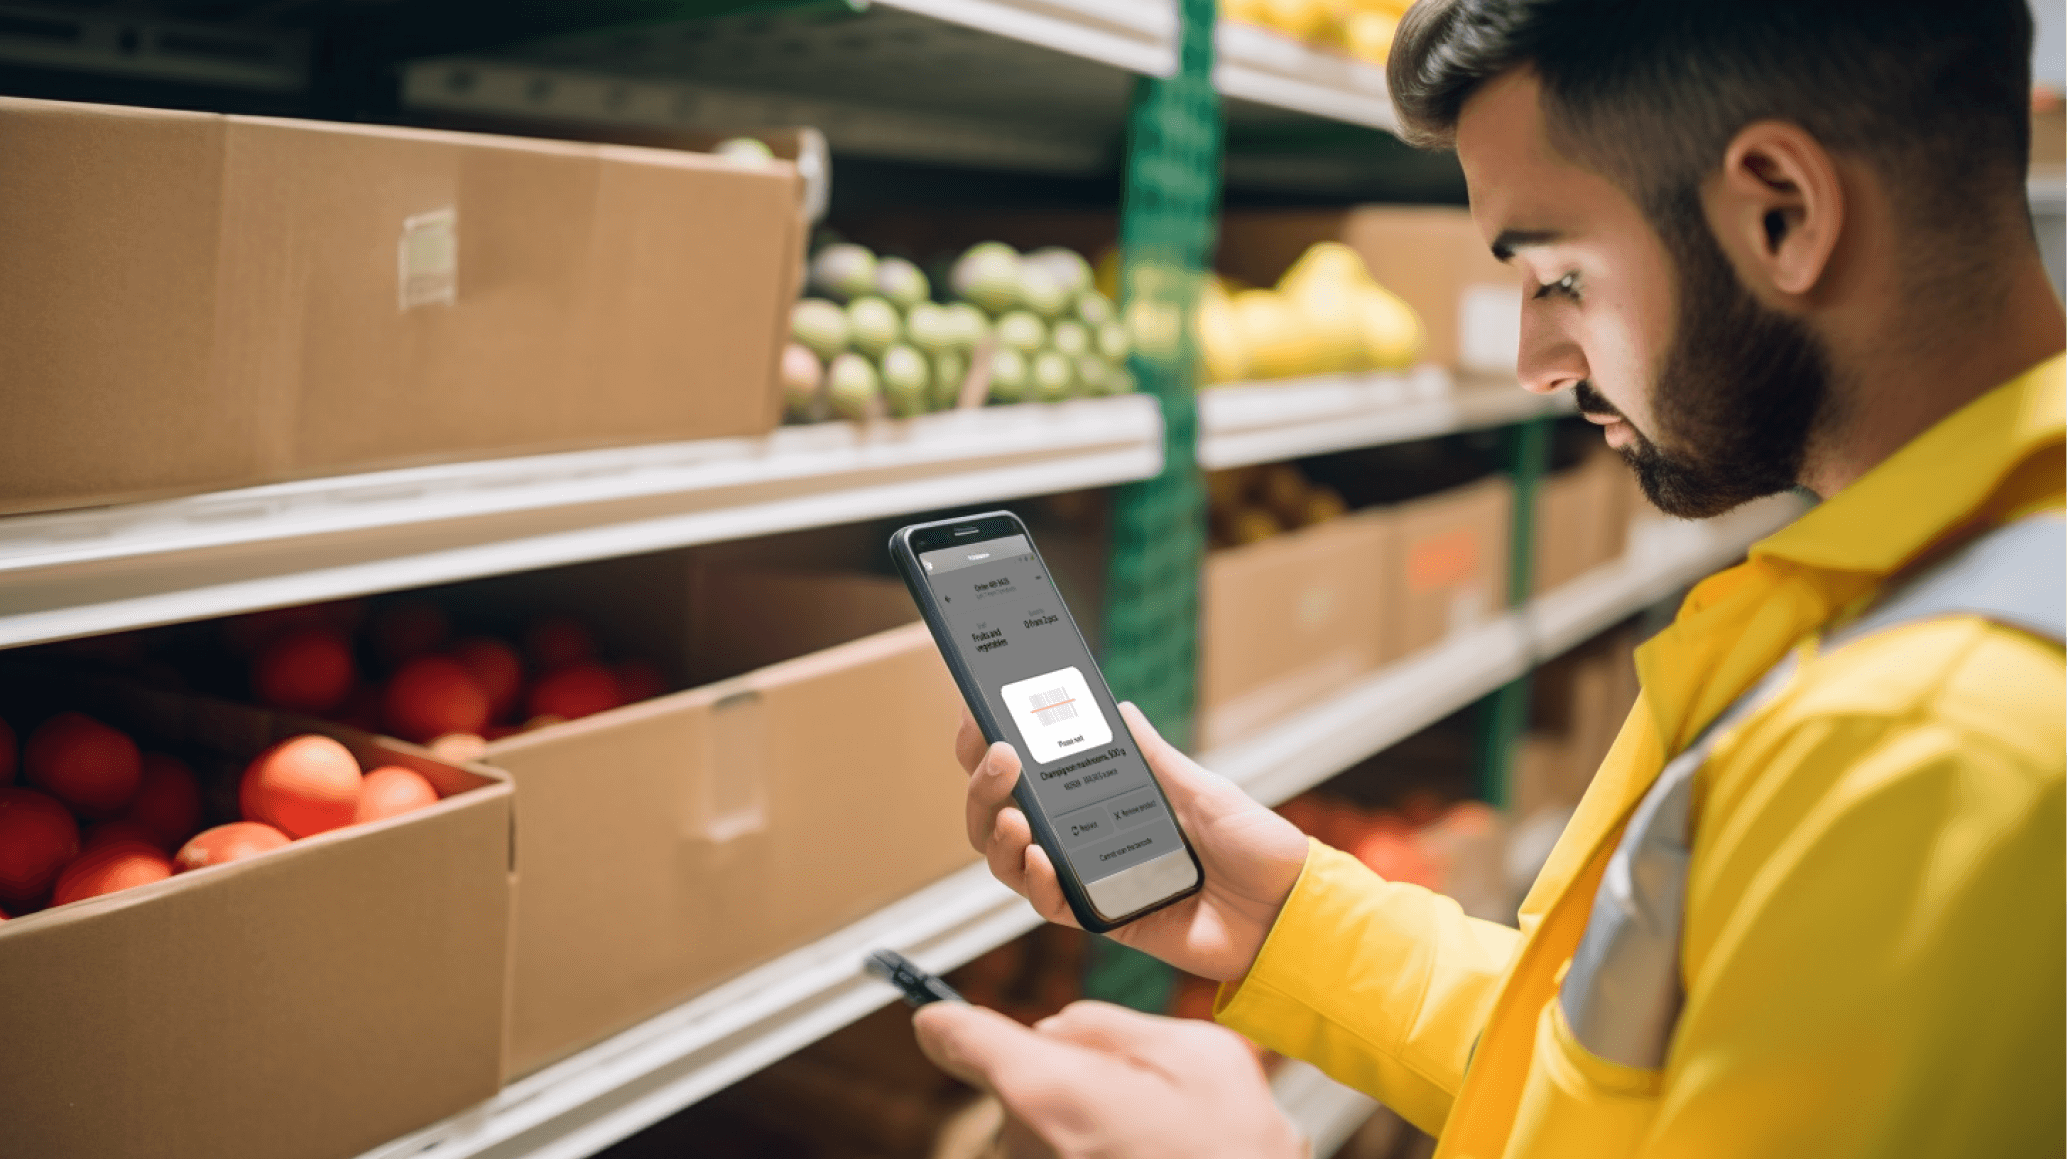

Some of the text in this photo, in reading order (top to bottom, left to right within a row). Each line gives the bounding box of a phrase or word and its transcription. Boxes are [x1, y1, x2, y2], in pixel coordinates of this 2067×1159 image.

[971, 628, 1002, 643] Fruits and
[975, 638, 1008, 653] vegetables
